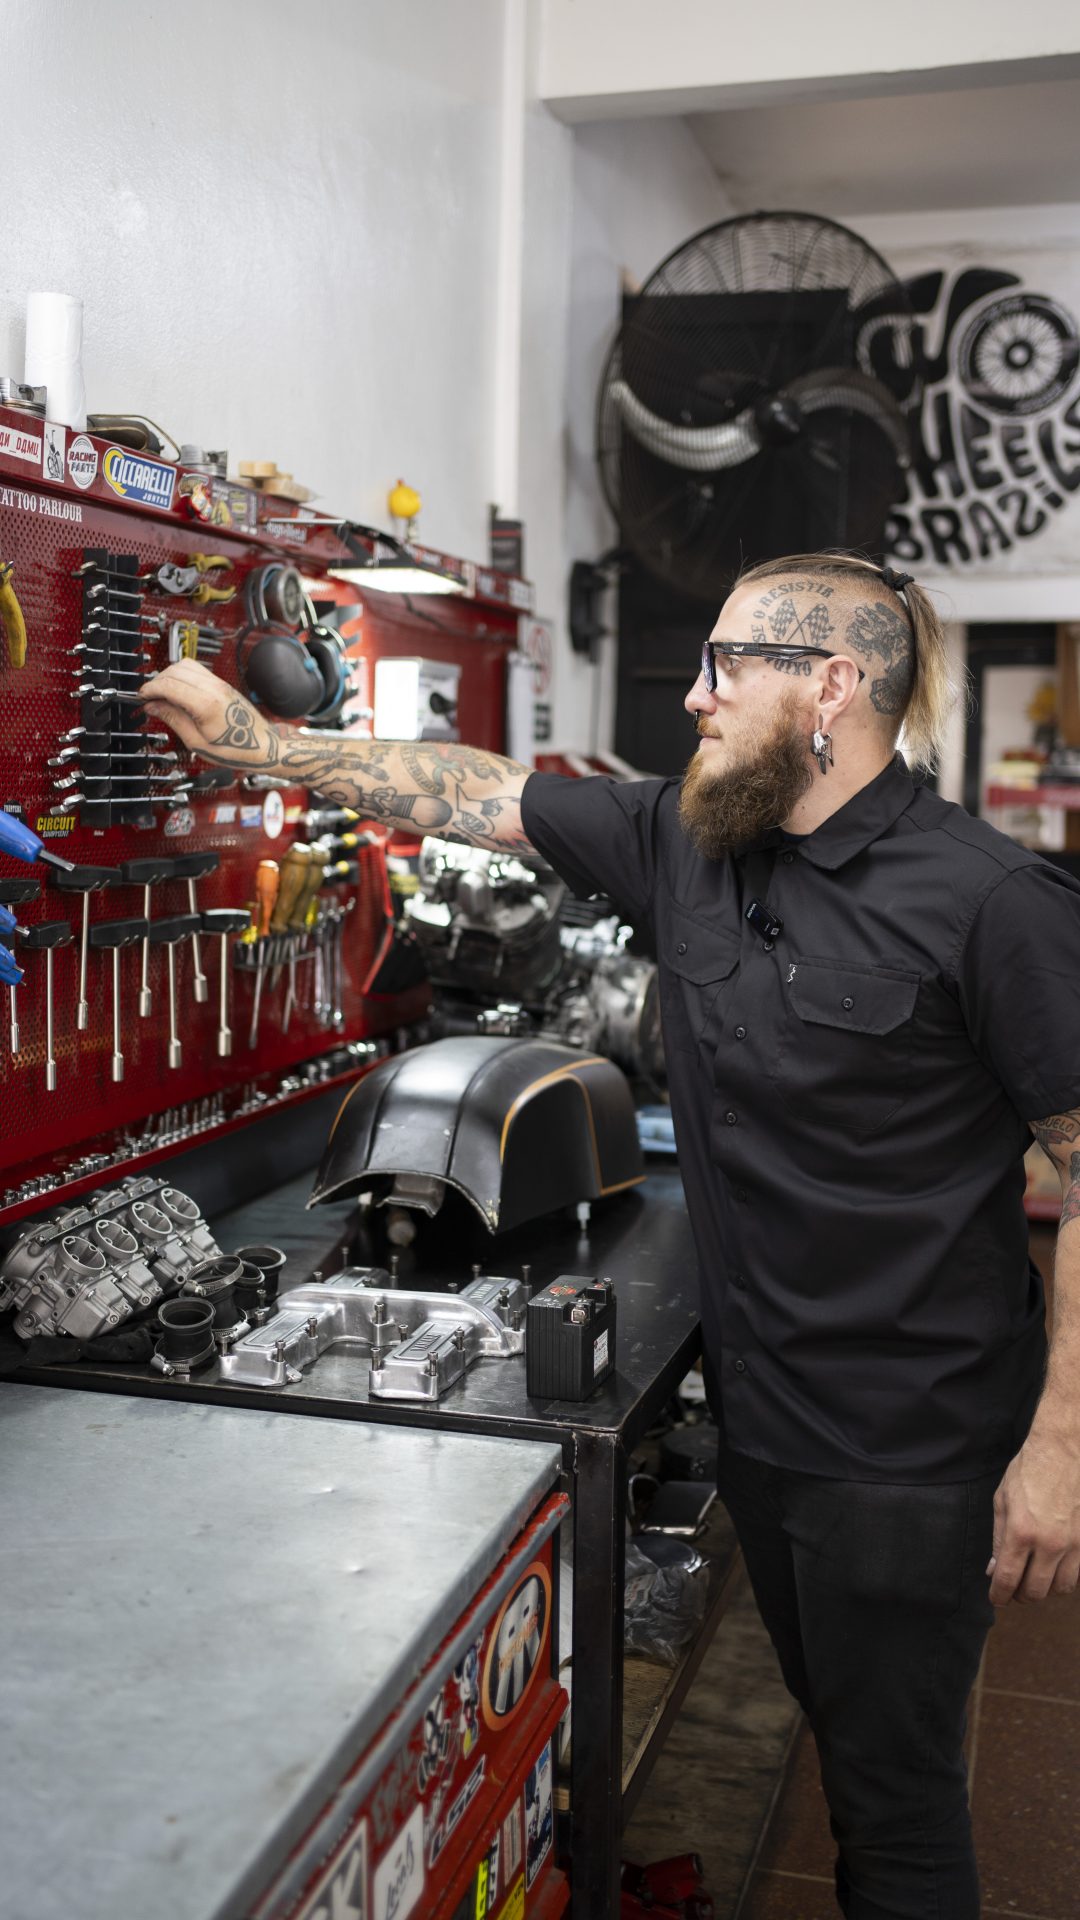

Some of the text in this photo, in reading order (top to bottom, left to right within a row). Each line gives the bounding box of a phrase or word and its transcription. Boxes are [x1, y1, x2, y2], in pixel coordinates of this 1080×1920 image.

[69, 450, 97, 463] RACING
[71, 462, 95, 474] PARTS
[110, 456, 173, 497] CICCARELLI
[142, 492, 169, 506] JUNTAS
[39, 496, 83, 523] PARLOUR
[37, 816, 76, 832] CIRCUIT
